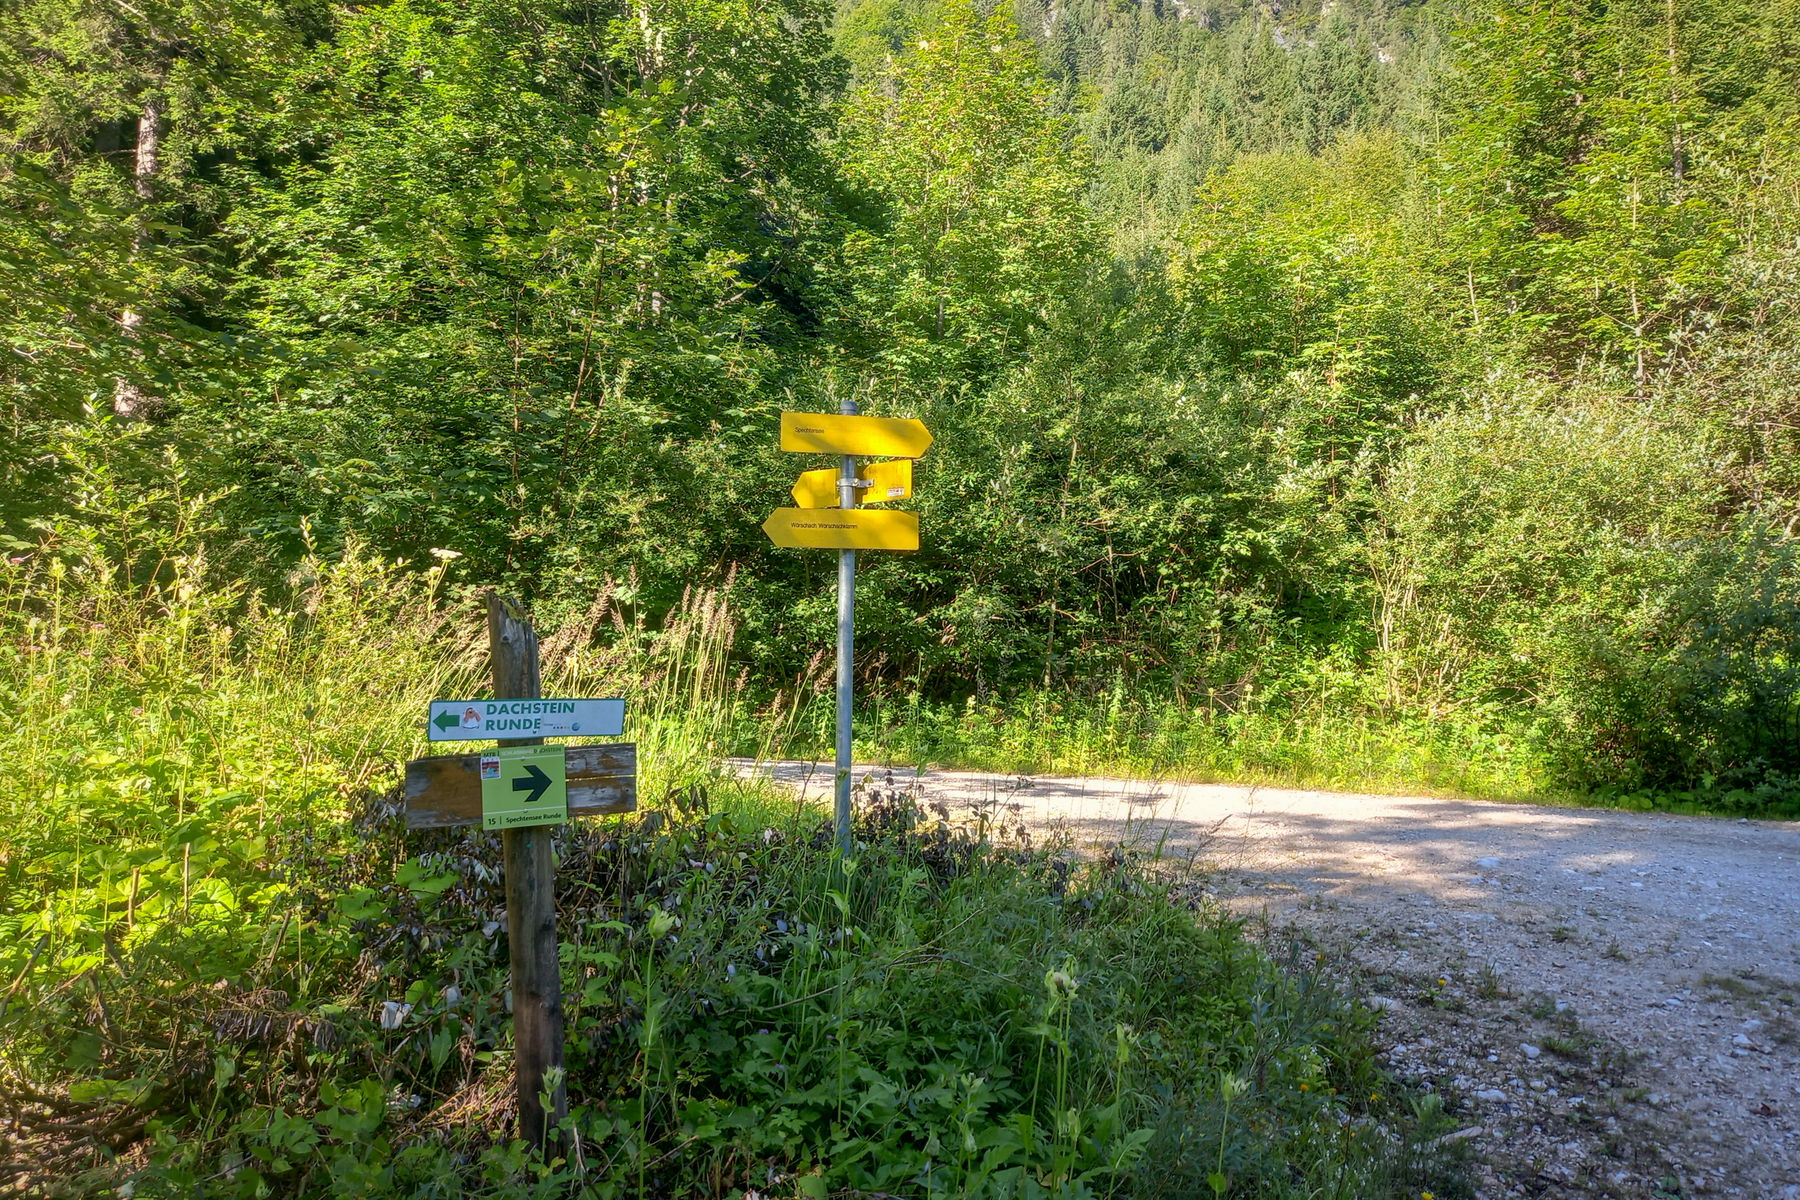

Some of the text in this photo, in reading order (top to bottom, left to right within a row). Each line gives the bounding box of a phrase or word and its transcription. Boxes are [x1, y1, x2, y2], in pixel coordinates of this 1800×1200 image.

[486, 703, 575, 715] DACHSTEIN
[485, 719, 541, 731] RUNDE
[505, 814, 543, 824] Spechtensee
